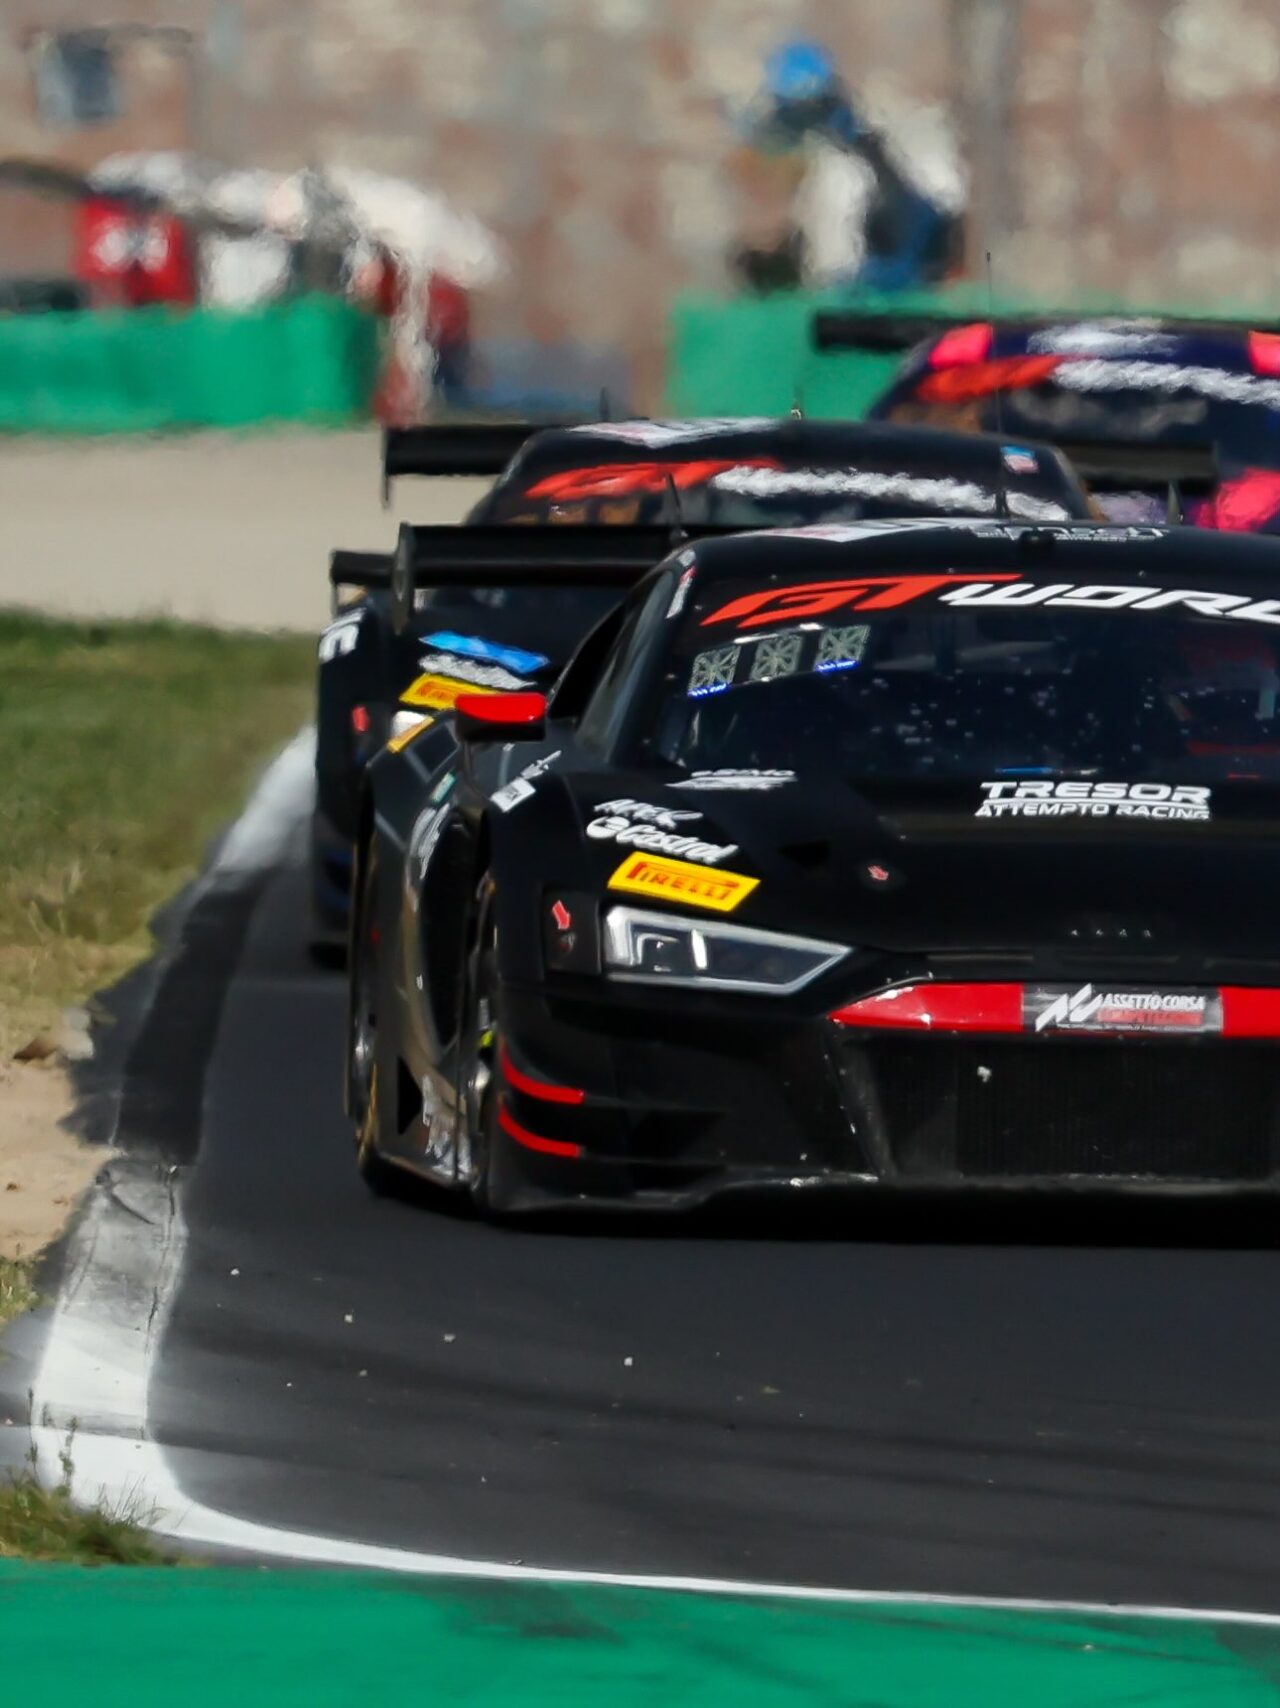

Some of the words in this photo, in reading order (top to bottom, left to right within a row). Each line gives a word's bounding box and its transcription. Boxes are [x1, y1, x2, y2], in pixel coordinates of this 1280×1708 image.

[980, 781, 1212, 805] TRESOR
[974, 802, 1110, 817] ATTEMPTO
[1115, 804, 1211, 820] RACING
[616, 823, 738, 865] Castrol
[626, 861, 740, 901] PIRELLI
[1102, 993, 1160, 1010] ASSETTO
[1160, 994, 1206, 1011] CORSA
